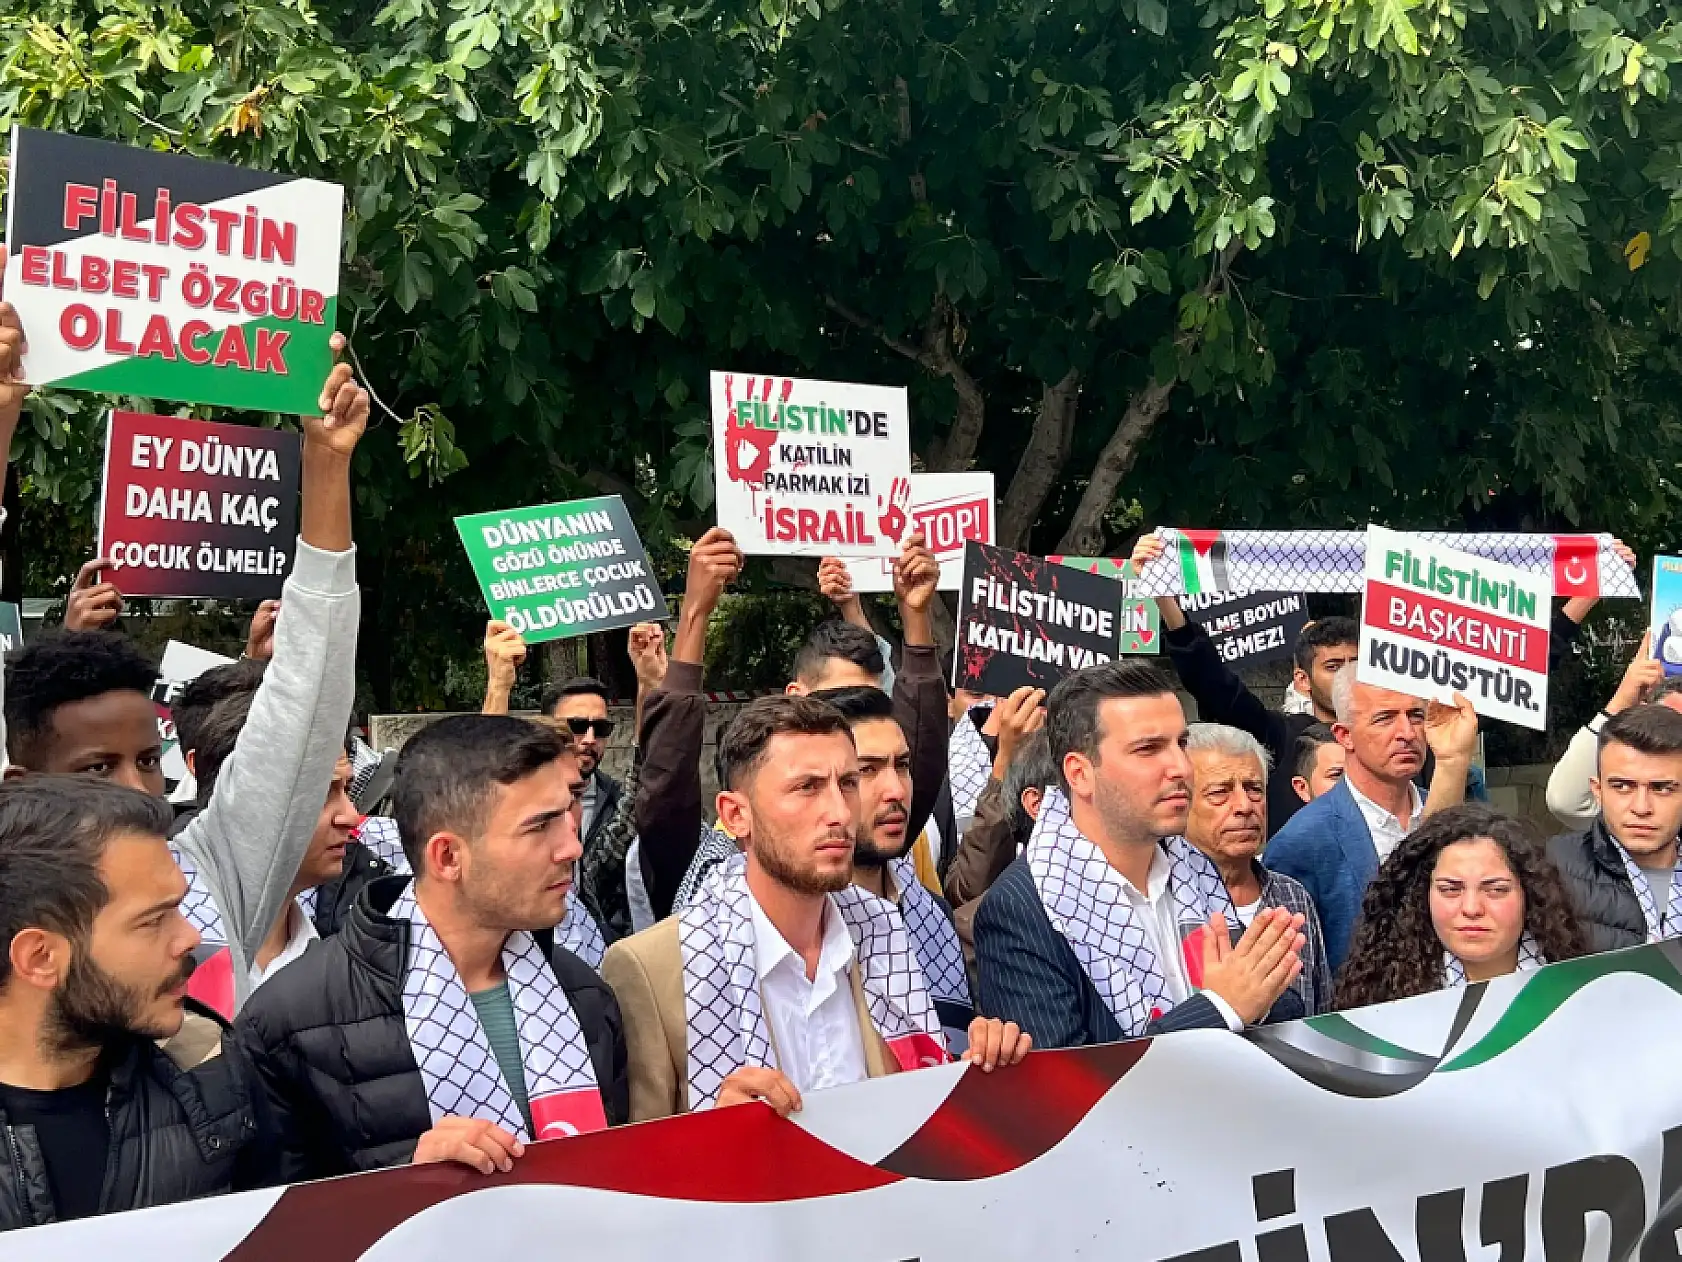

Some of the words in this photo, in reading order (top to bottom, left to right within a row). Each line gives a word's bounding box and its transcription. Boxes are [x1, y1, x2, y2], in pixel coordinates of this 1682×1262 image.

[63, 177, 297, 266] FİLİSTİN
[21, 245, 169, 302] ELBET
[181, 262, 326, 325] ÖZGÜR
[58, 303, 290, 374] OLACAK
[736, 395, 889, 438] FİLİSTİN'DE
[131, 434, 173, 470] EY
[179, 435, 281, 481] DÜNYA
[779, 441, 852, 467] KATİLİN
[764, 472, 844, 494] PARMAK
[847, 473, 871, 496] İZİ
[125, 483, 213, 523] DAHA
[220, 492, 280, 534] KAÇ
[481, 509, 614, 549] DÜNYANIN
[764, 497, 876, 545] İSRAİL
[109, 540, 192, 571] ÇOCUK
[196, 541, 286, 575] ÖLMELİ?
[491, 546, 545, 573] GÖZÜ
[548, 538, 626, 563] ÖNÜNDE
[489, 570, 582, 600] BİNLERCE
[582, 560, 646, 587] ÇOCUK
[1385, 549, 1536, 621] FİLİSTİN'İN
[504, 583, 656, 634] ÖLDÜRÜLDÜ
[971, 575, 1113, 638] FİLİSTİN'DE
[1201, 611, 1241, 637] LME
[1242, 594, 1301, 626] BOYUN
[1389, 596, 1527, 662] BAŞKENTİ
[967, 621, 1063, 667] KATLİAM
[1369, 638, 1540, 711] KUDÜS'TÜR.
